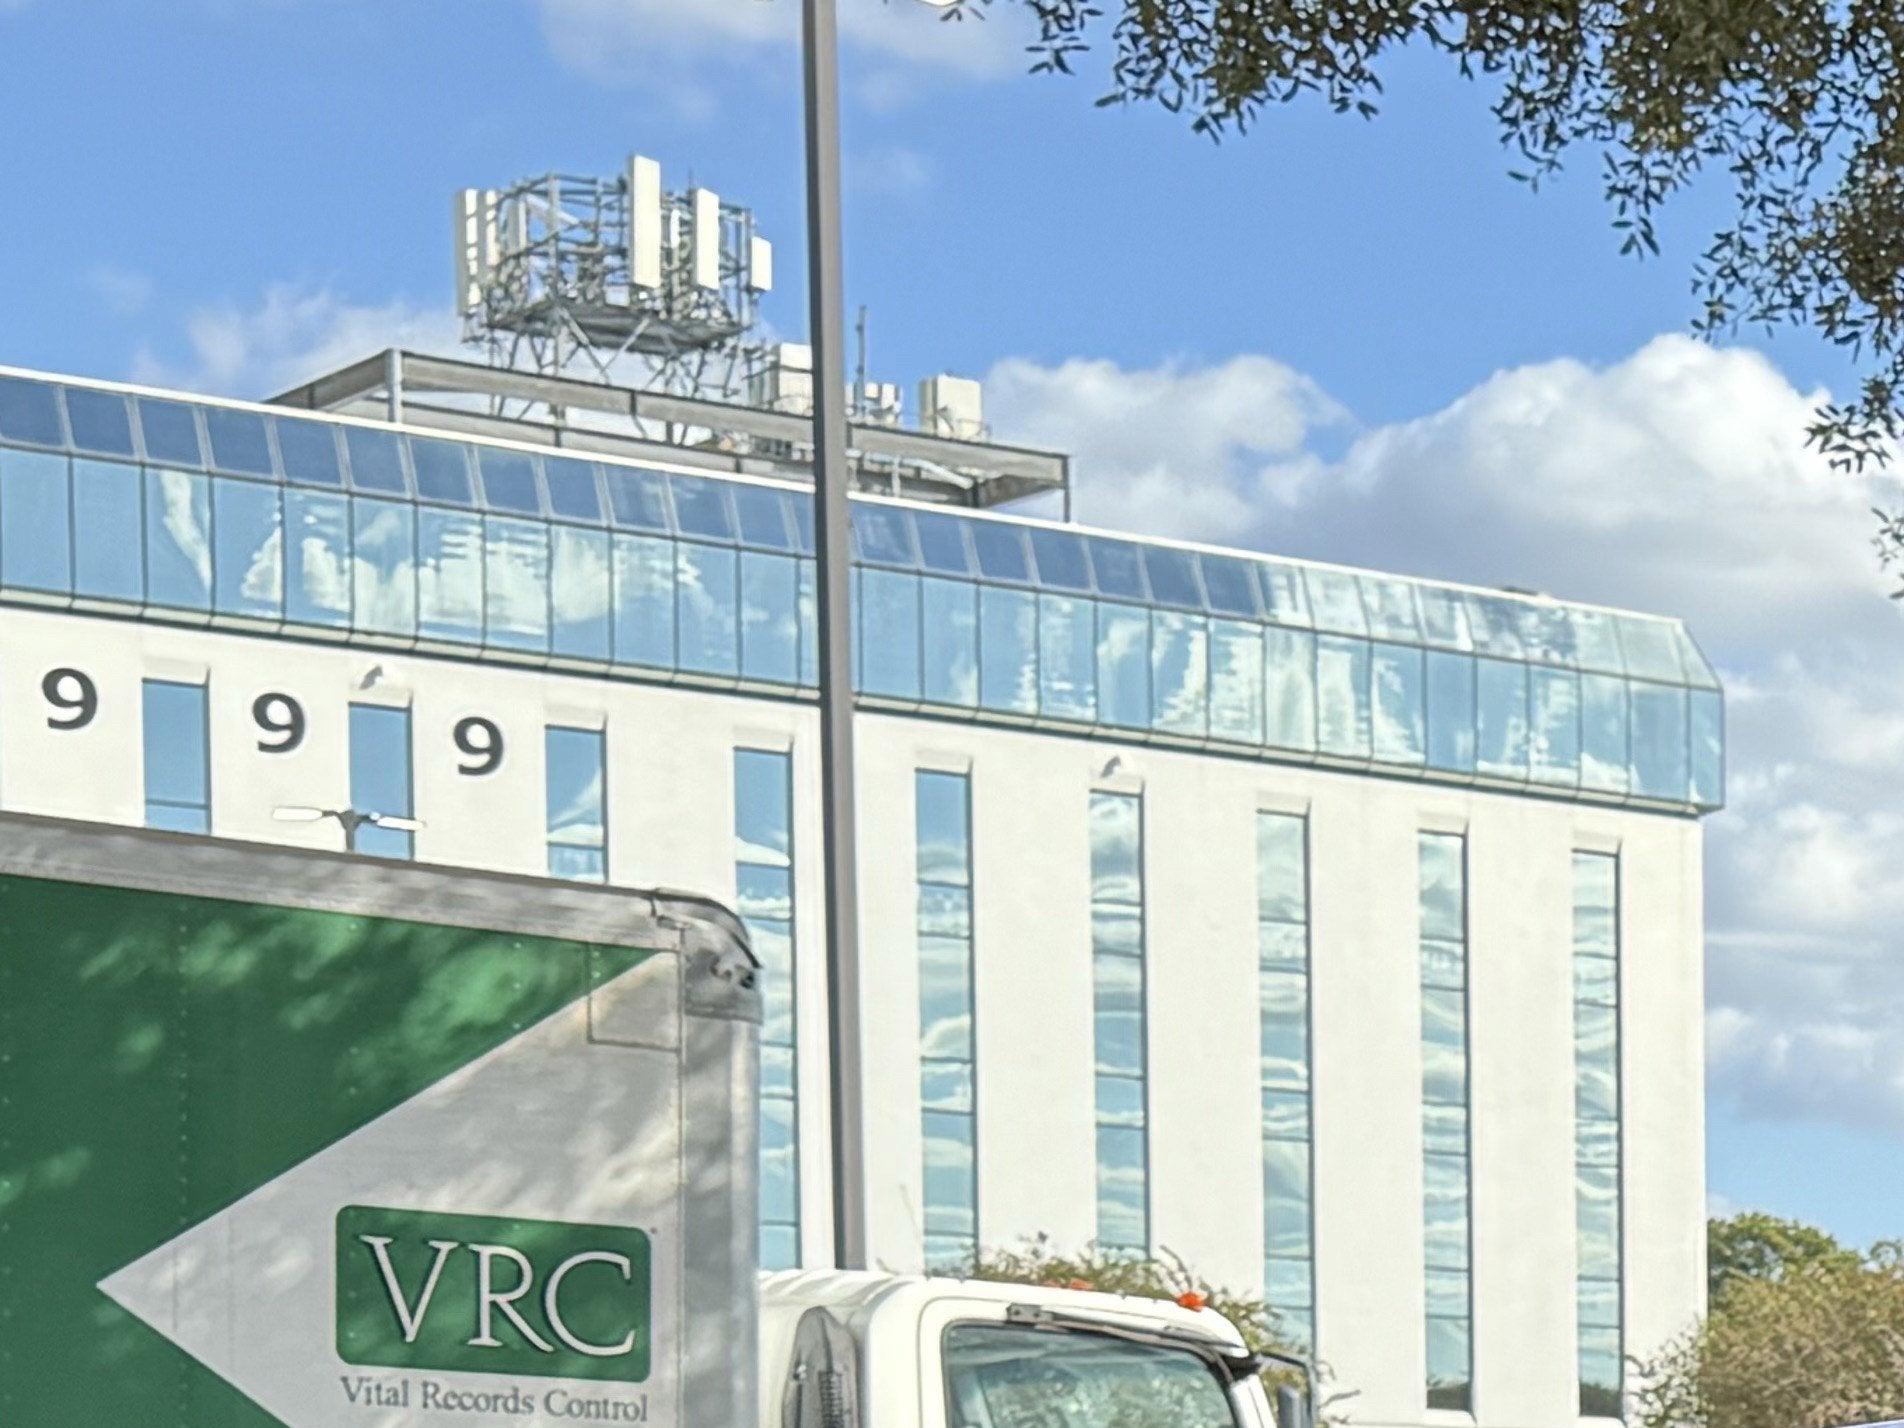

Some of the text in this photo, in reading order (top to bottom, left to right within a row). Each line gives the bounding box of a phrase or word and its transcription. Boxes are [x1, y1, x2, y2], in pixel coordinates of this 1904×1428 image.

[42, 668, 503, 776] 9 9 9
[359, 1235, 635, 1356] VRC
[340, 1376, 648, 1422] Vital Records Control
